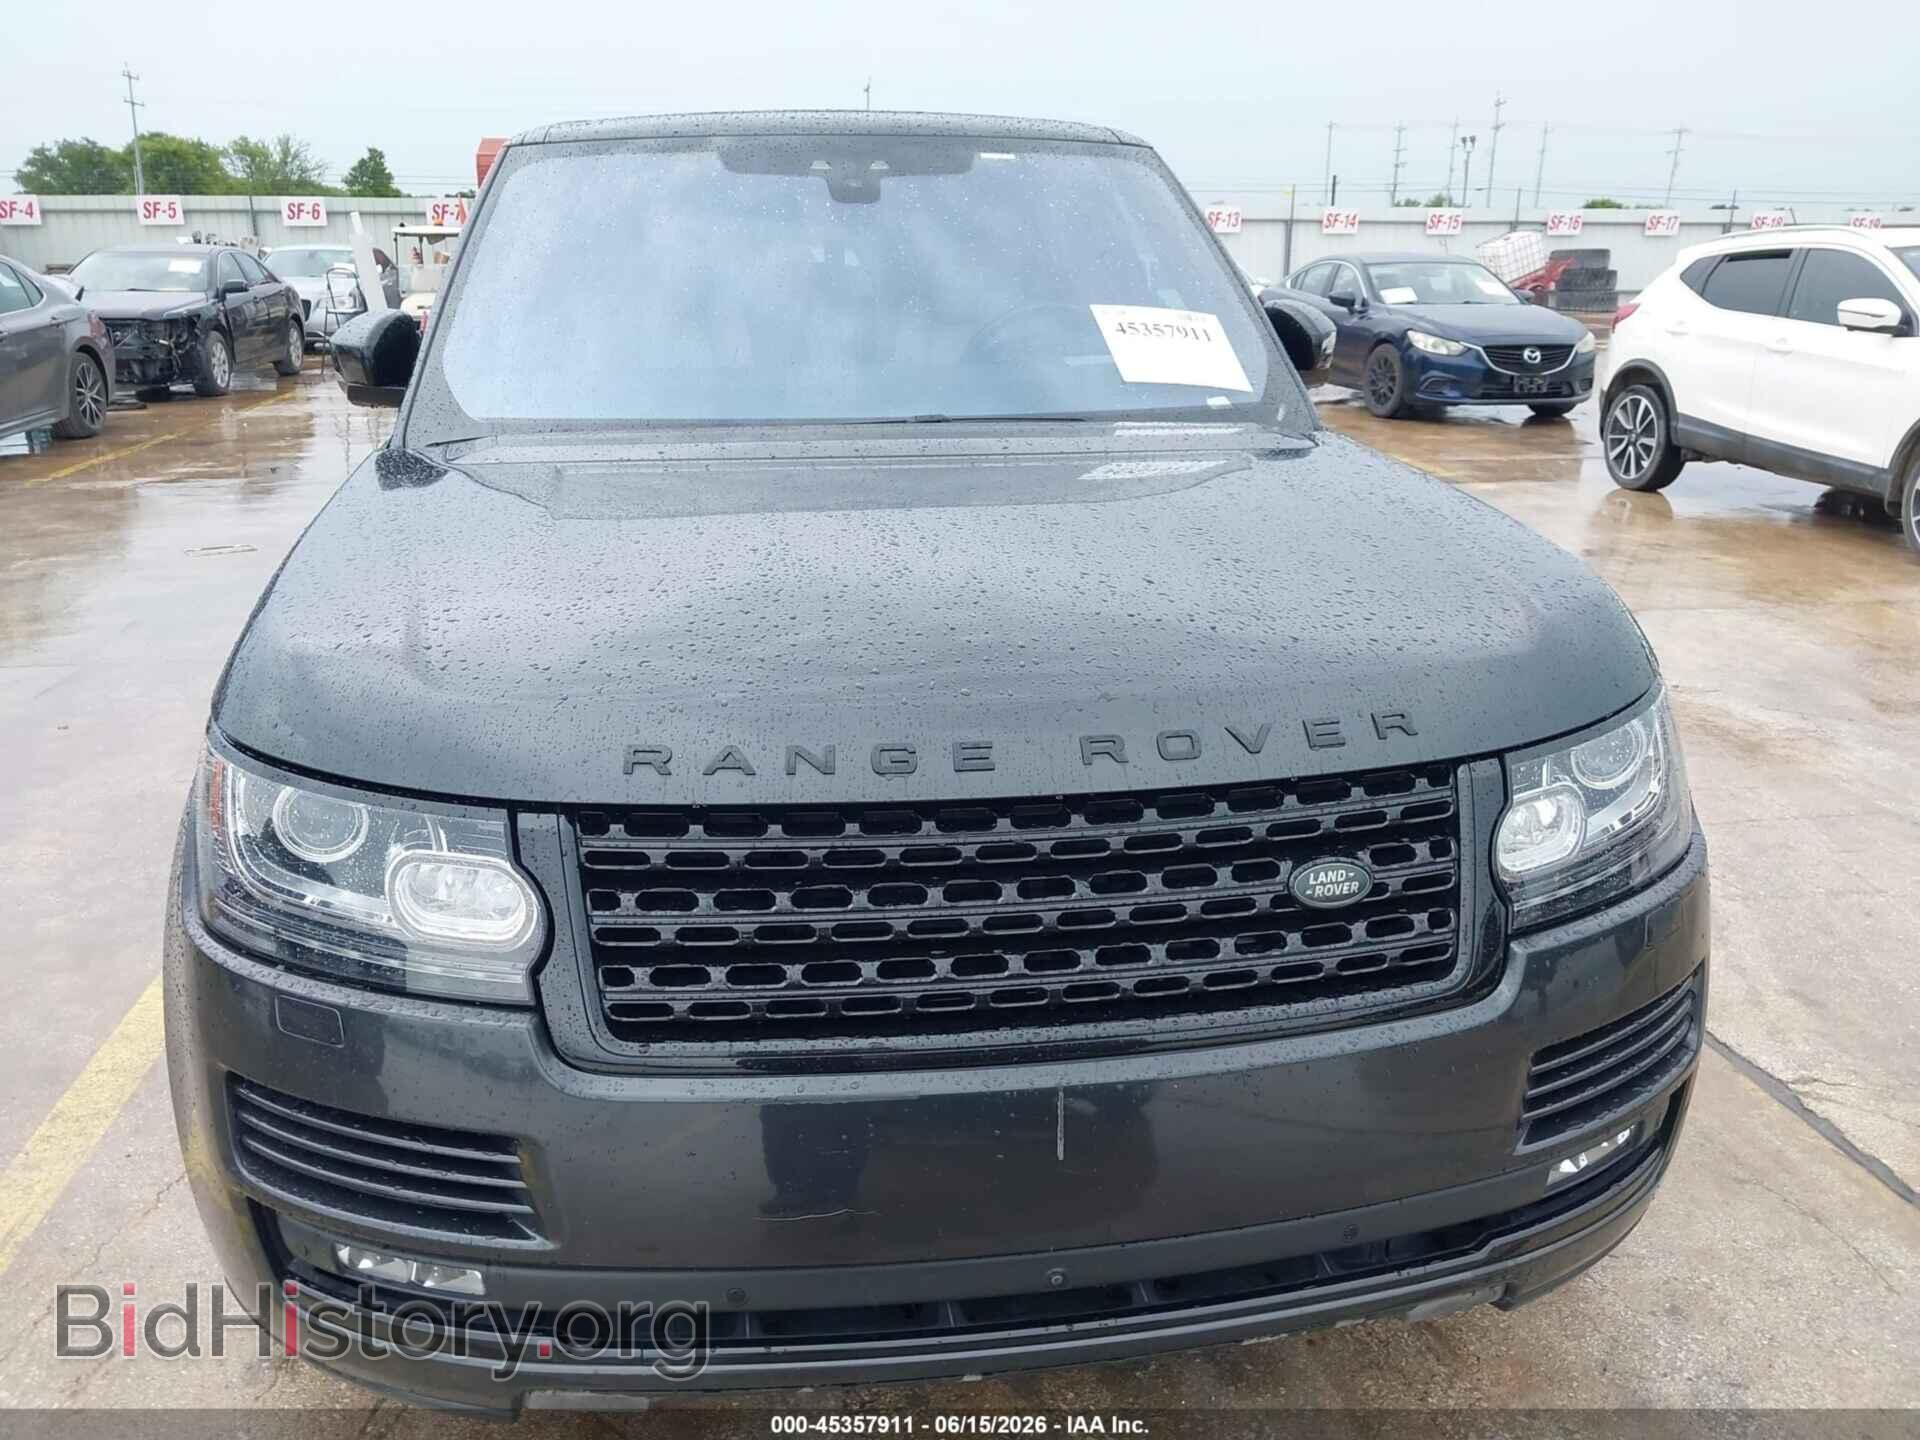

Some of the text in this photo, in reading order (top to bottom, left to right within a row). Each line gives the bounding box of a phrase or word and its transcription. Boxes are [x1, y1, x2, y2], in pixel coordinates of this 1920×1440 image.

[0, 201, 34, 219] SF-4
[143, 201, 177, 219] SF-5
[287, 202, 321, 220] SF-6
[432, 203, 463, 221] SF-7
[1207, 211, 1241, 229] SF-13
[1325, 213, 1358, 229] SF-14
[1428, 214, 1461, 231] SF-15
[1550, 215, 1581, 231] SF-16
[1647, 215, 1679, 231] SF-17
[1115, 322, 1212, 342] 45357911
[622, 712, 1419, 777] RANGE ROVER
